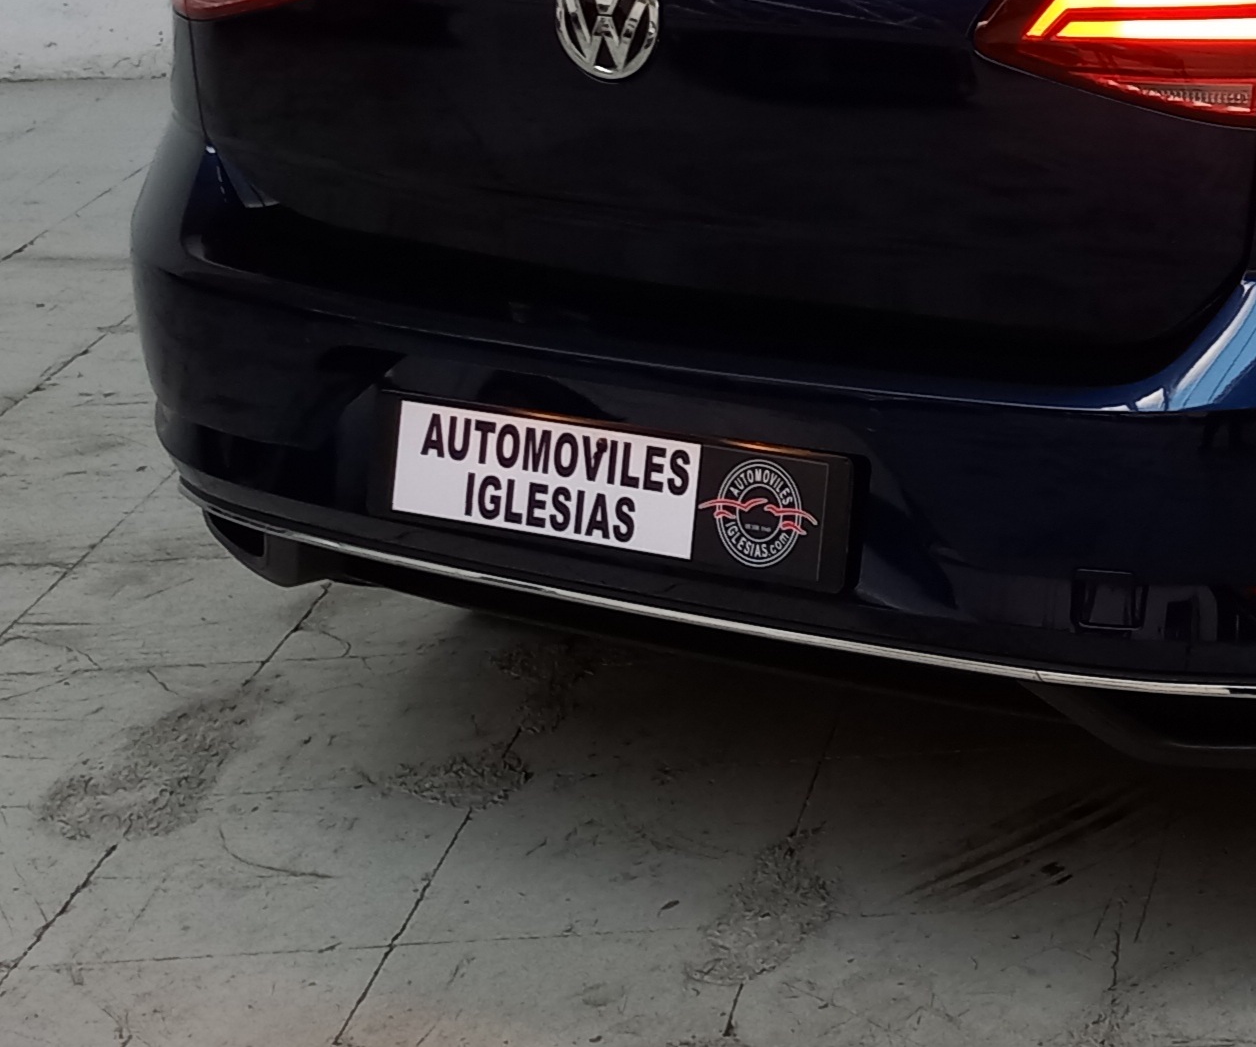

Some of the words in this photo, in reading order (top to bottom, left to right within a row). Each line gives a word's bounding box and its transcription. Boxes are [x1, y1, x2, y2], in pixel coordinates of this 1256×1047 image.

[421, 412, 690, 496] AUTOMOVILES
[729, 468, 793, 505] AUTOMOVILES
[464, 472, 636, 542] IGLESIAS
